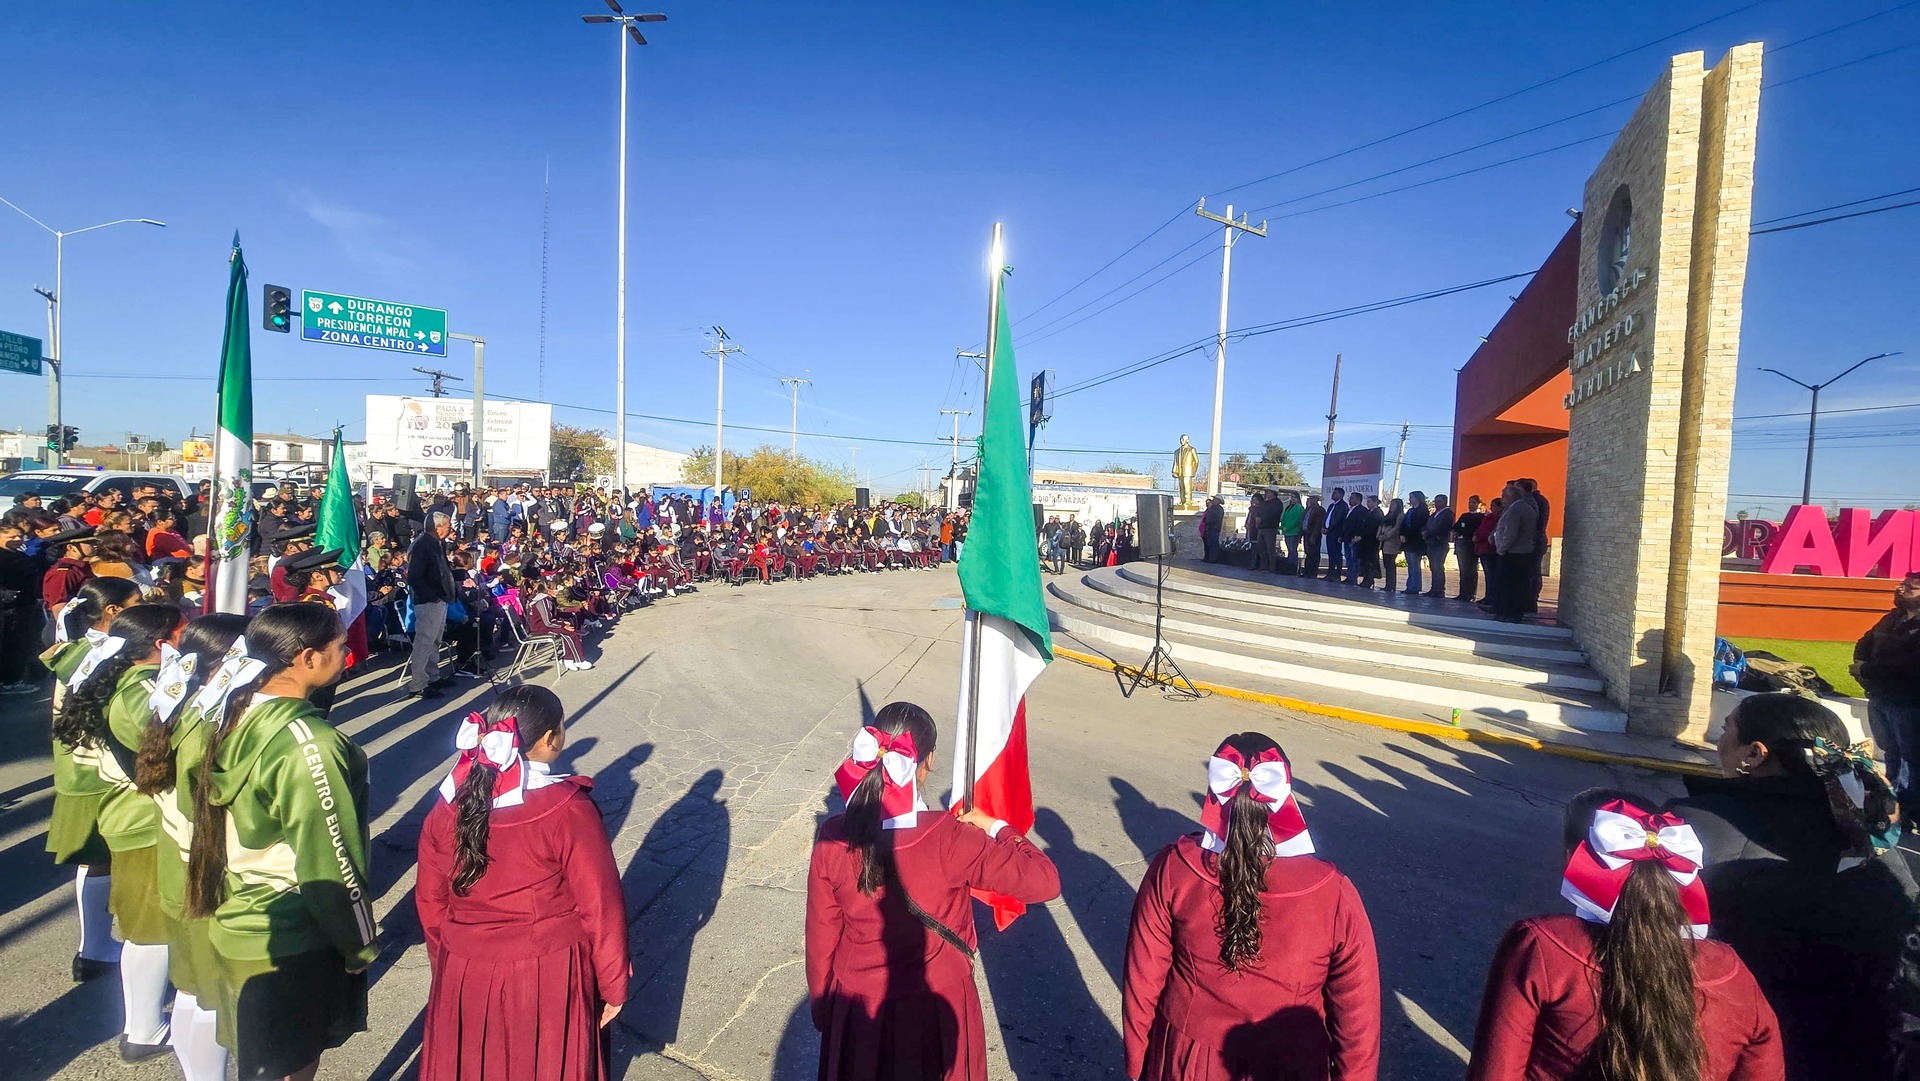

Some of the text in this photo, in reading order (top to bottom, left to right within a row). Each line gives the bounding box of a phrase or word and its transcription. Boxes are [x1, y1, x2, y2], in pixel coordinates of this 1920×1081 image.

[311, 302, 321, 310] 30
[348, 300, 413, 318] DURANGO
[1567, 268, 1641, 344] FRANCISCO
[318, 318, 411, 339] PRESIDENCIA MPAL
[348, 310, 412, 328] TORREON
[4, 343, 28, 354] PEDRO
[320, 330, 415, 352] ZONA CENTRO
[435, 421, 453, 430] 20
[302, 743, 335, 811] CENTRO
[325, 813, 362, 902] EDUCATIVO
